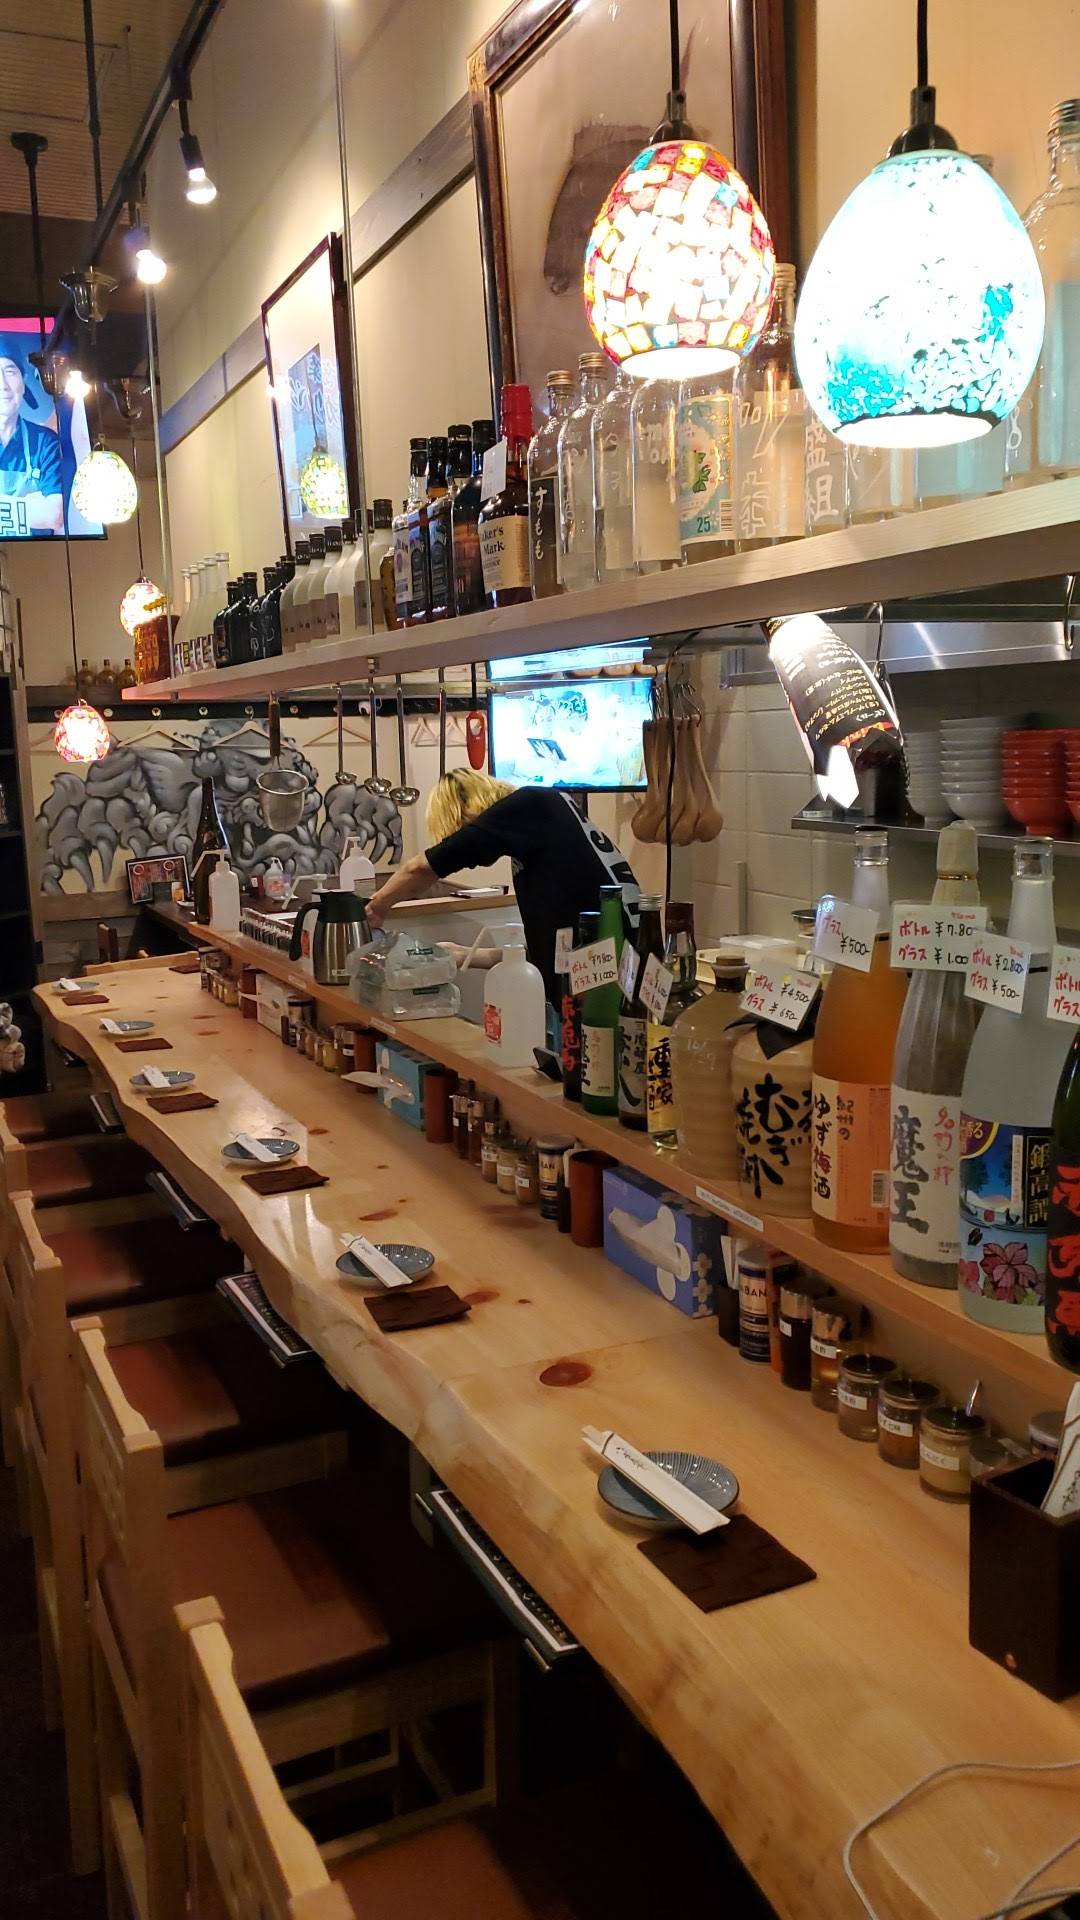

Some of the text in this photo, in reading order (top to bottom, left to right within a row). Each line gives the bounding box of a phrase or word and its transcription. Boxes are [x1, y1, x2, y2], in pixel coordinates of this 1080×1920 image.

[697, 516, 711, 533] 25
[900, 920, 930, 937] ボトル
[898, 944, 927, 961] グラス
[972, 948, 992, 967] ボトル
[754, 975, 774, 992] ボトル
[970, 971, 988, 991] グラス
[746, 993, 765, 1011] グラス
[755, 1072, 800, 1167] むぎ
[892, 1105, 930, 1234] 魔王
